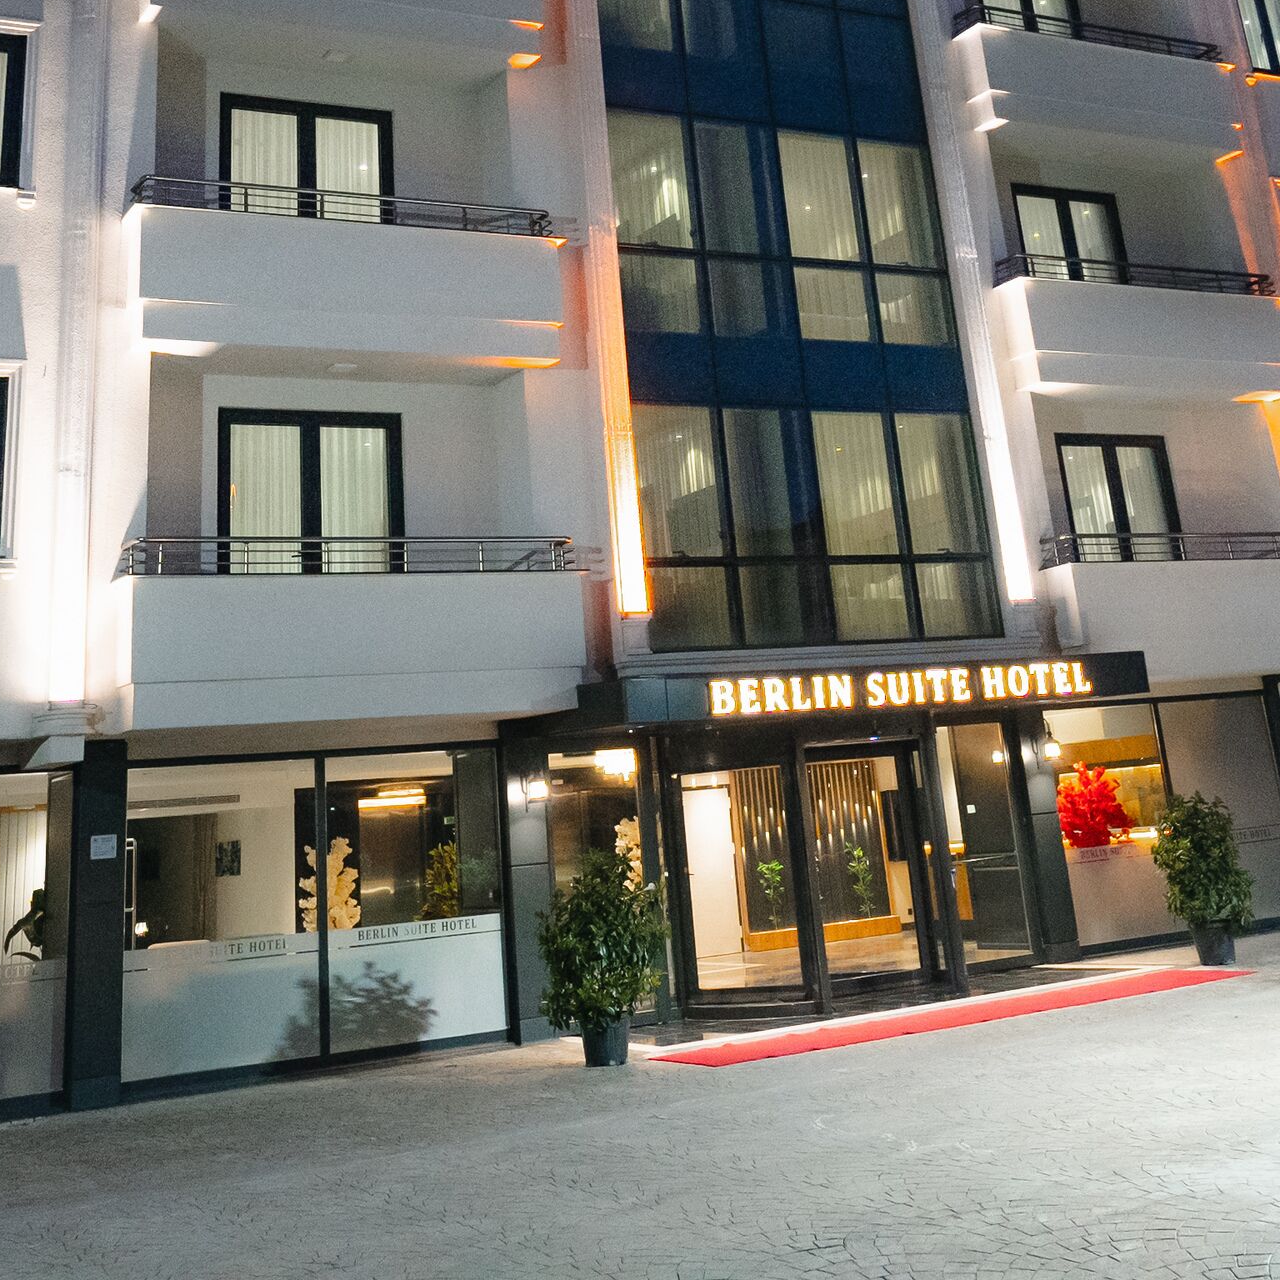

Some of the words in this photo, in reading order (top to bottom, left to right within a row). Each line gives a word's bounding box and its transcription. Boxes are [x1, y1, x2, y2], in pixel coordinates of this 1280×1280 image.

[709, 674, 854, 717] BERLIN
[865, 666, 972, 708] SUITE
[980, 660, 1093, 699] HOTEL
[357, 926, 399, 941] BERLIN
[404, 922, 437, 936] SUITE
[441, 918, 477, 932] HOTEL
